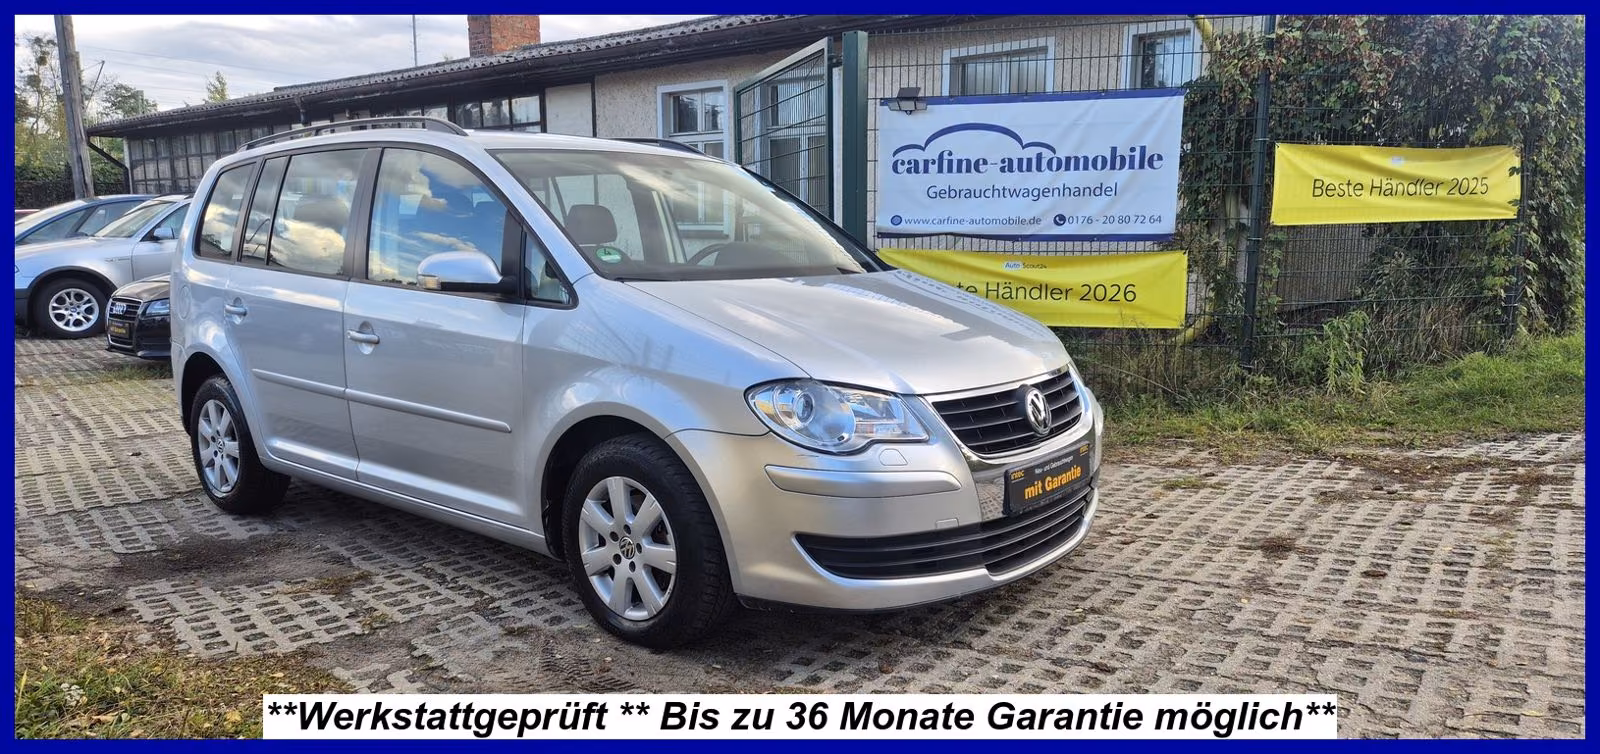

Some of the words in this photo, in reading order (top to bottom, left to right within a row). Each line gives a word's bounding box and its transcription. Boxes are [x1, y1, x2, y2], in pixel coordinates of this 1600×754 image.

[891, 145, 1164, 175] carfine-automobile
[926, 182, 1118, 202] Gebrauchtwagenhandel
[1312, 178, 1364, 198] Beste
[1369, 177, 1444, 197] Händler
[1446, 176, 1489, 196] 2025
[904, 215, 1042, 226] www.carfine-automobile.de
[1067, 215, 1094, 225] 0176
[1102, 215, 1115, 225] 20
[1117, 214, 1131, 225] 80
[1133, 214, 1146, 224] 72
[1148, 214, 1162, 225] 64
[985, 281, 1073, 302] Händler
[1079, 283, 1137, 302] 2026
[1024, 481, 1043, 500] mit
[1045, 465, 1081, 491] Garantie
